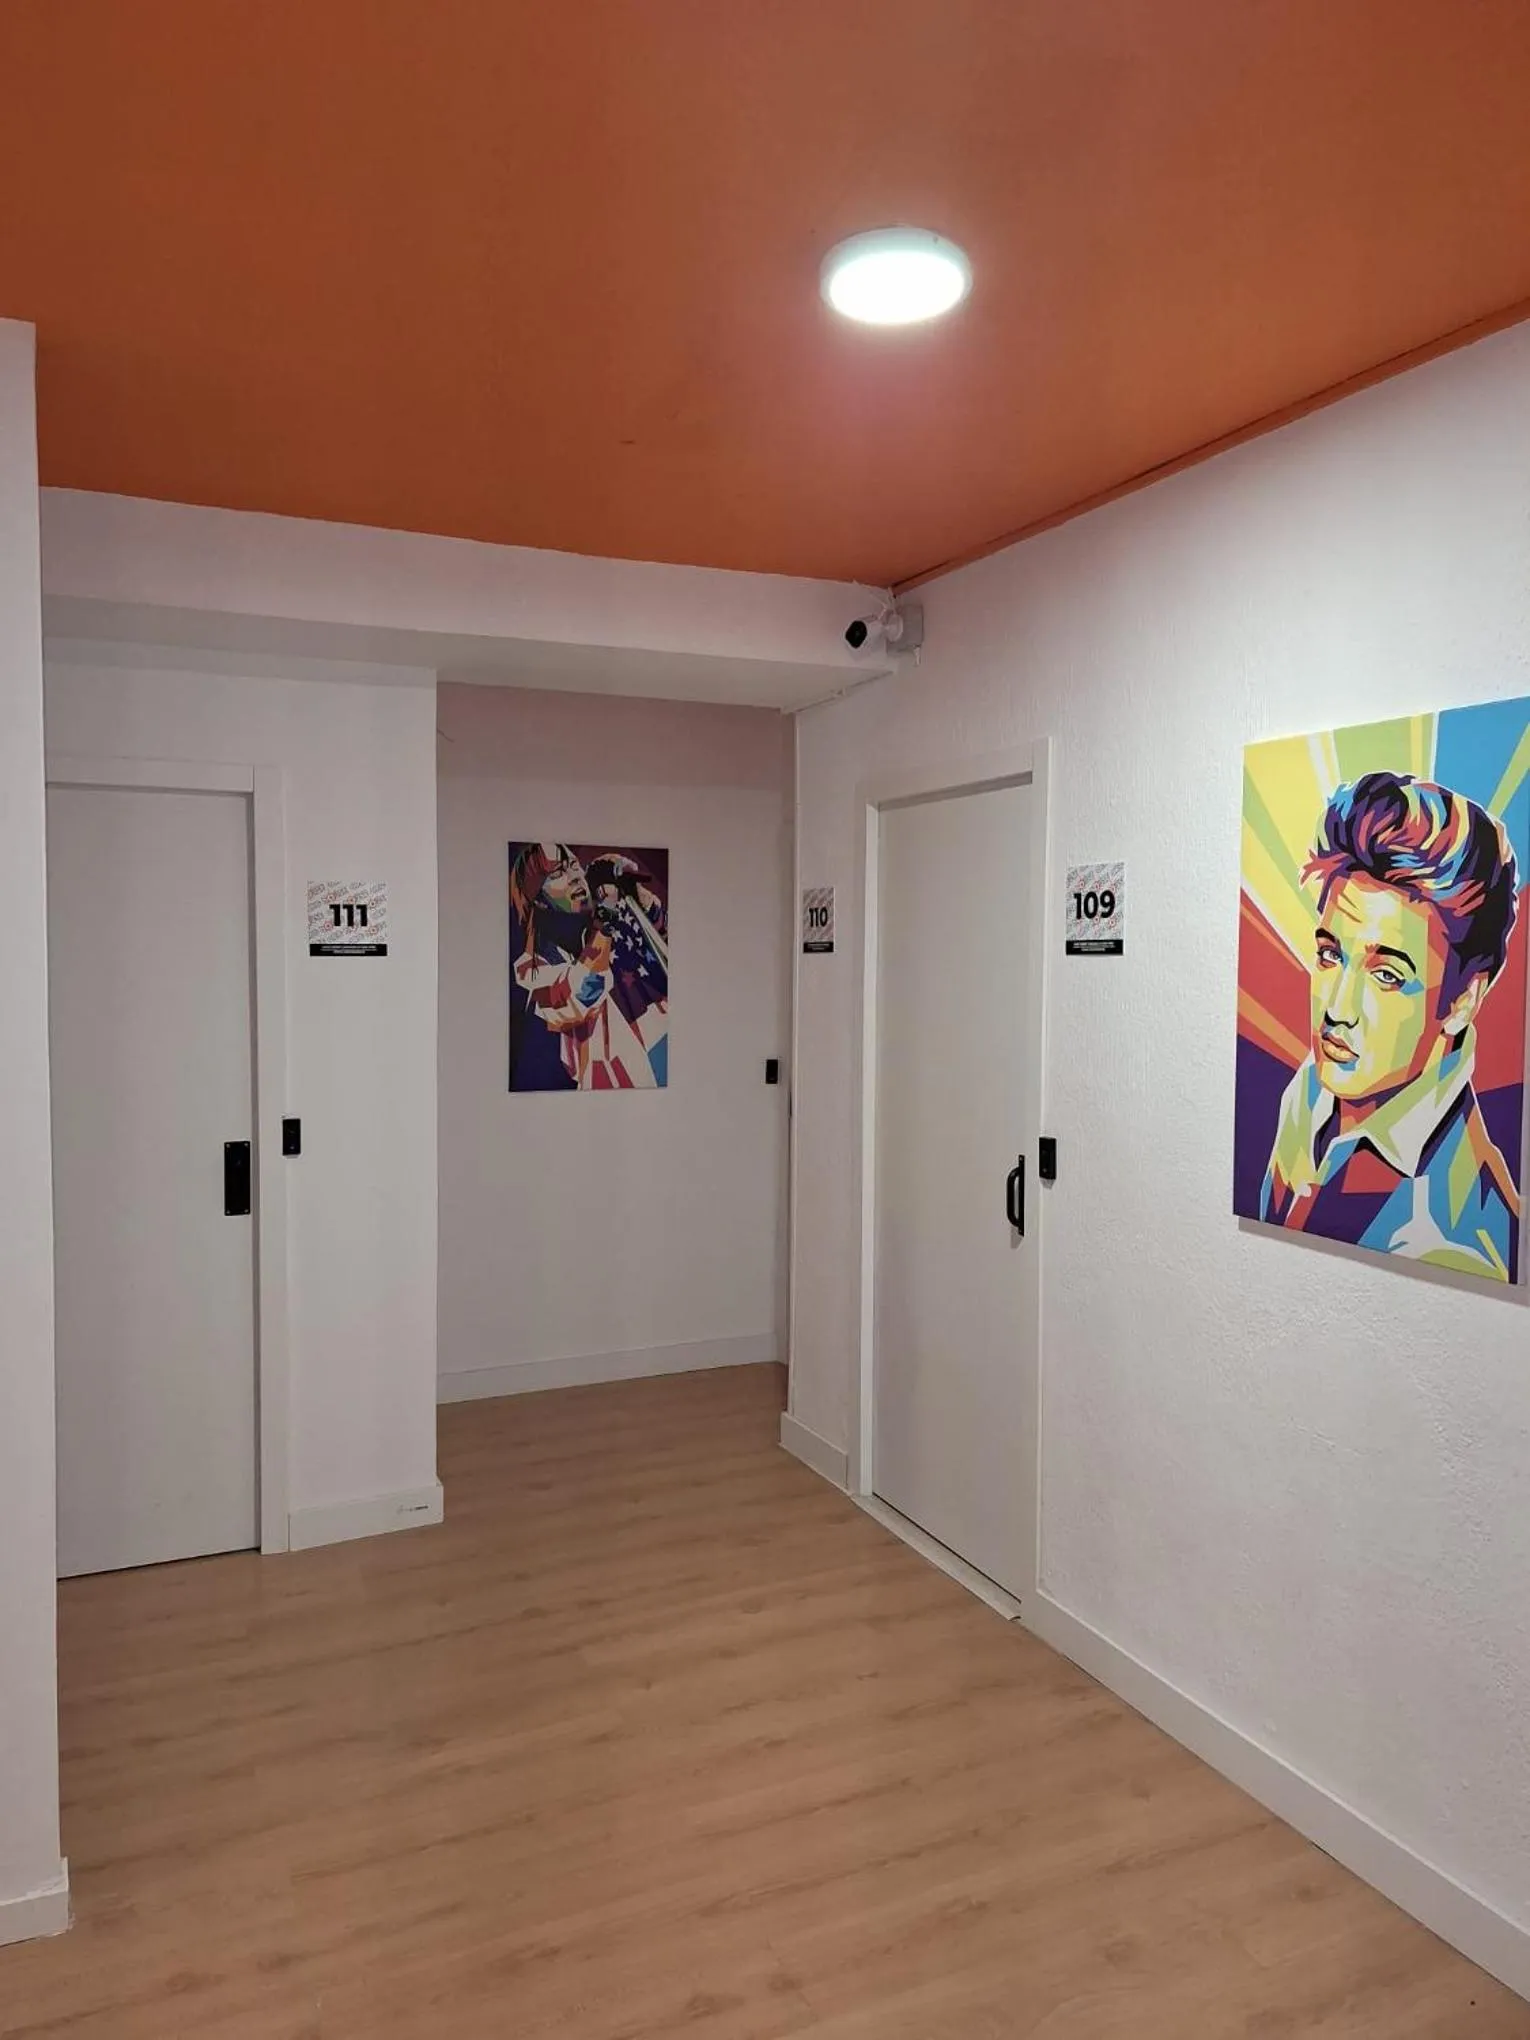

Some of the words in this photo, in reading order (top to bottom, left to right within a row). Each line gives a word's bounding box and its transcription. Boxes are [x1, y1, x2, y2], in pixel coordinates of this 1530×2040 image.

[329, 904, 368, 927] 111
[1073, 890, 1115, 920] 109
[808, 907, 828, 928] 110
